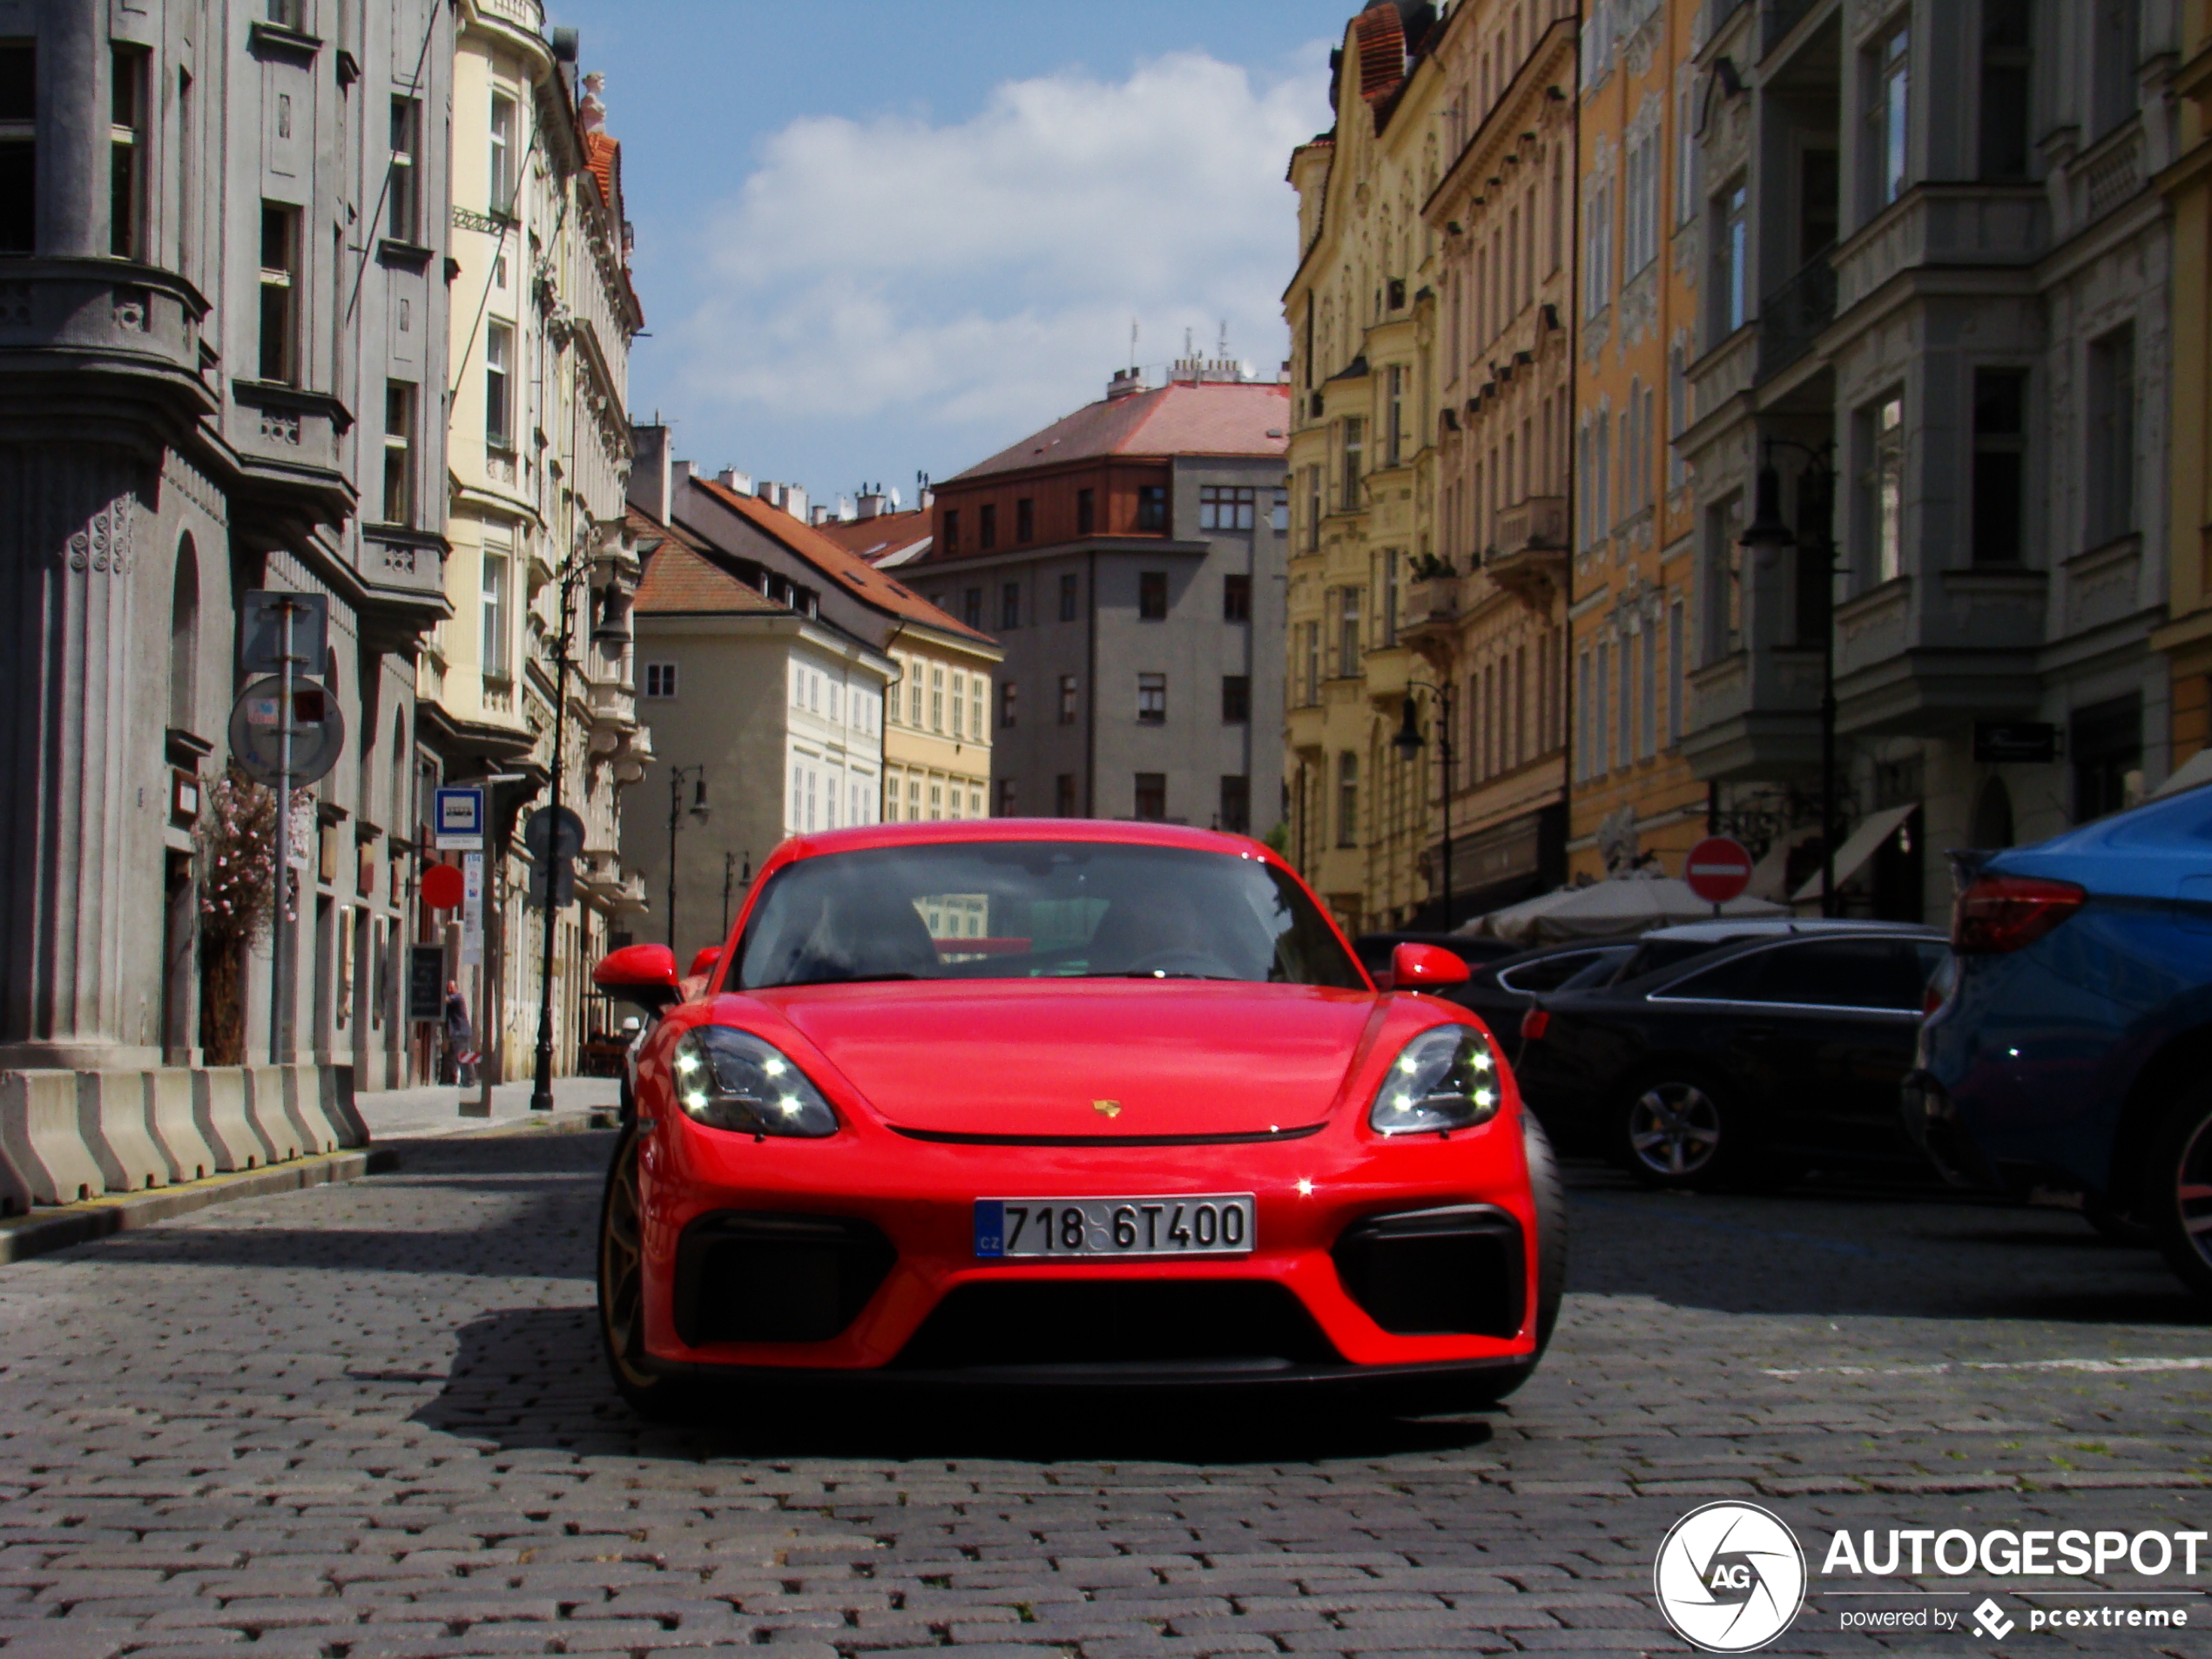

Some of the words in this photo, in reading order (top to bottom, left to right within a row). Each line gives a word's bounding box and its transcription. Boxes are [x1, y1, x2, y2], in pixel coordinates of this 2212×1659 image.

[1005, 1206, 1085, 1250] 718
[1113, 1202, 1244, 1248] 6T400
[980, 1237, 1000, 1250] CZ
